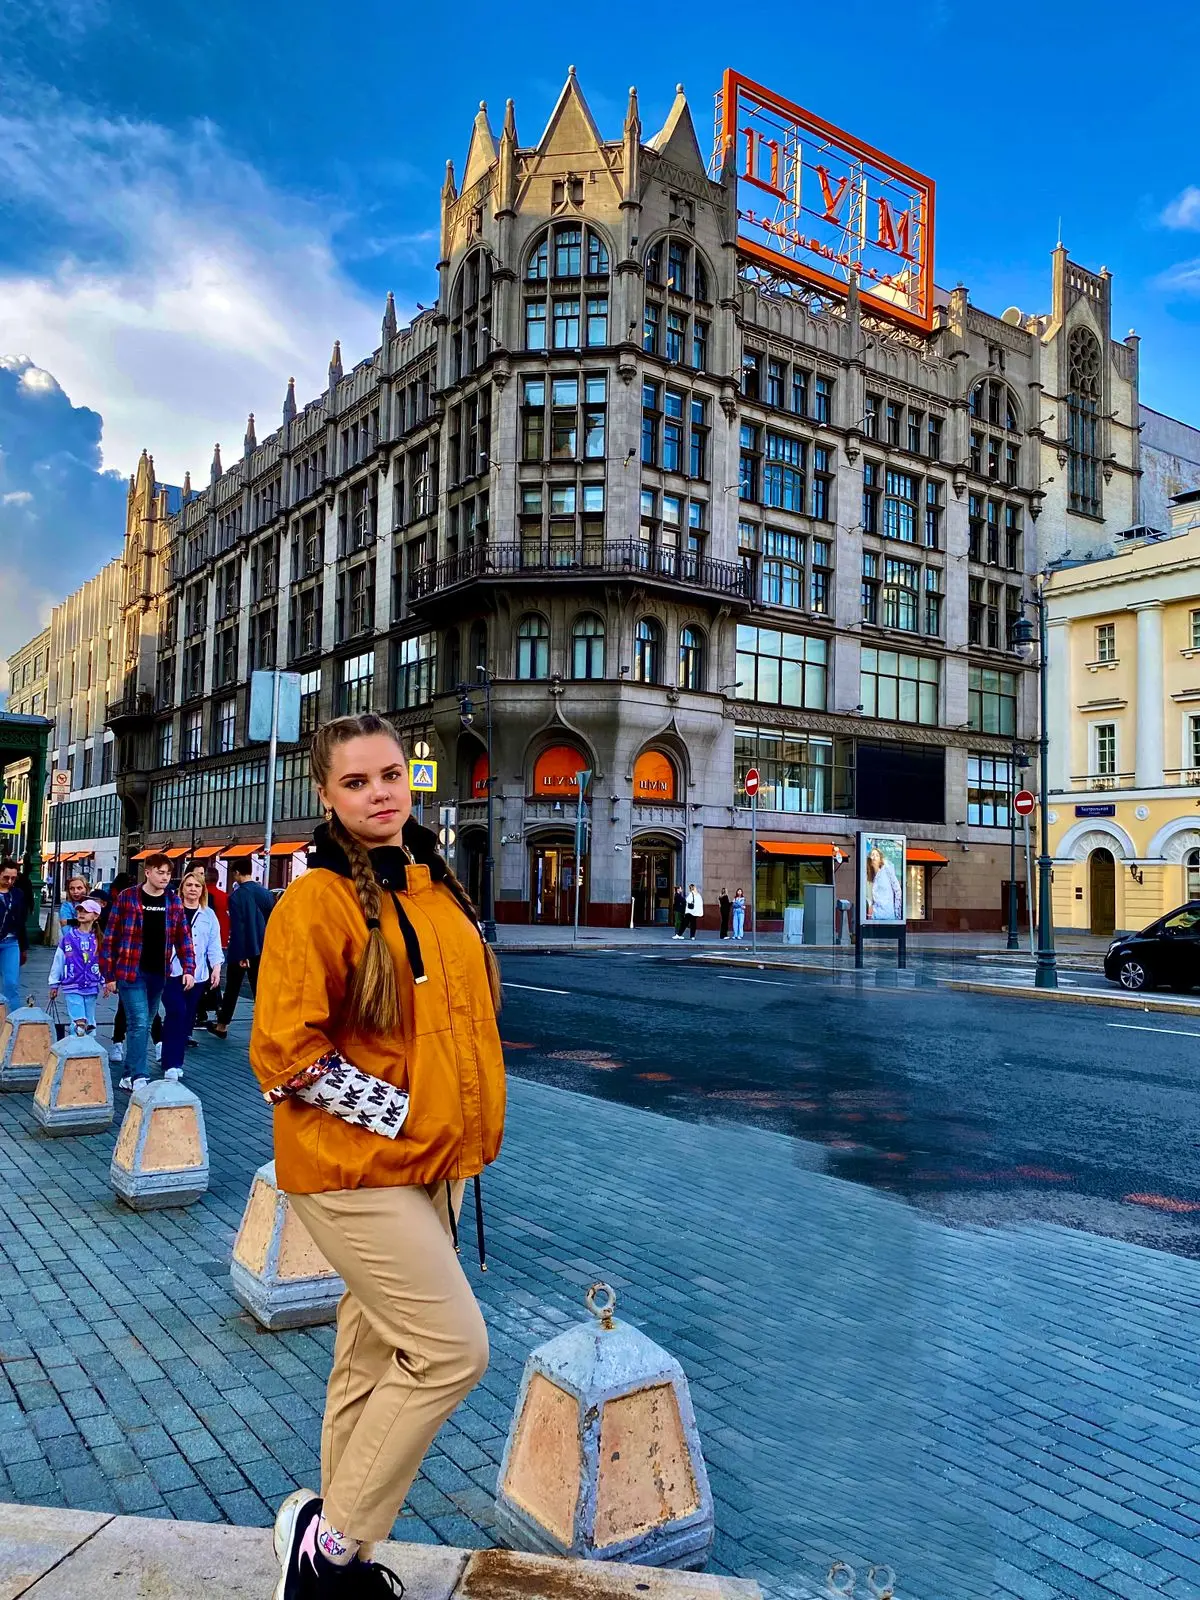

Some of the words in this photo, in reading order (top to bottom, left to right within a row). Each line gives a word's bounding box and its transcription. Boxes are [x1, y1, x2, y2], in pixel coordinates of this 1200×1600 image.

[338, 1084, 364, 1110] MK
[367, 1081, 390, 1106] MK
[380, 1100, 405, 1128] MK
